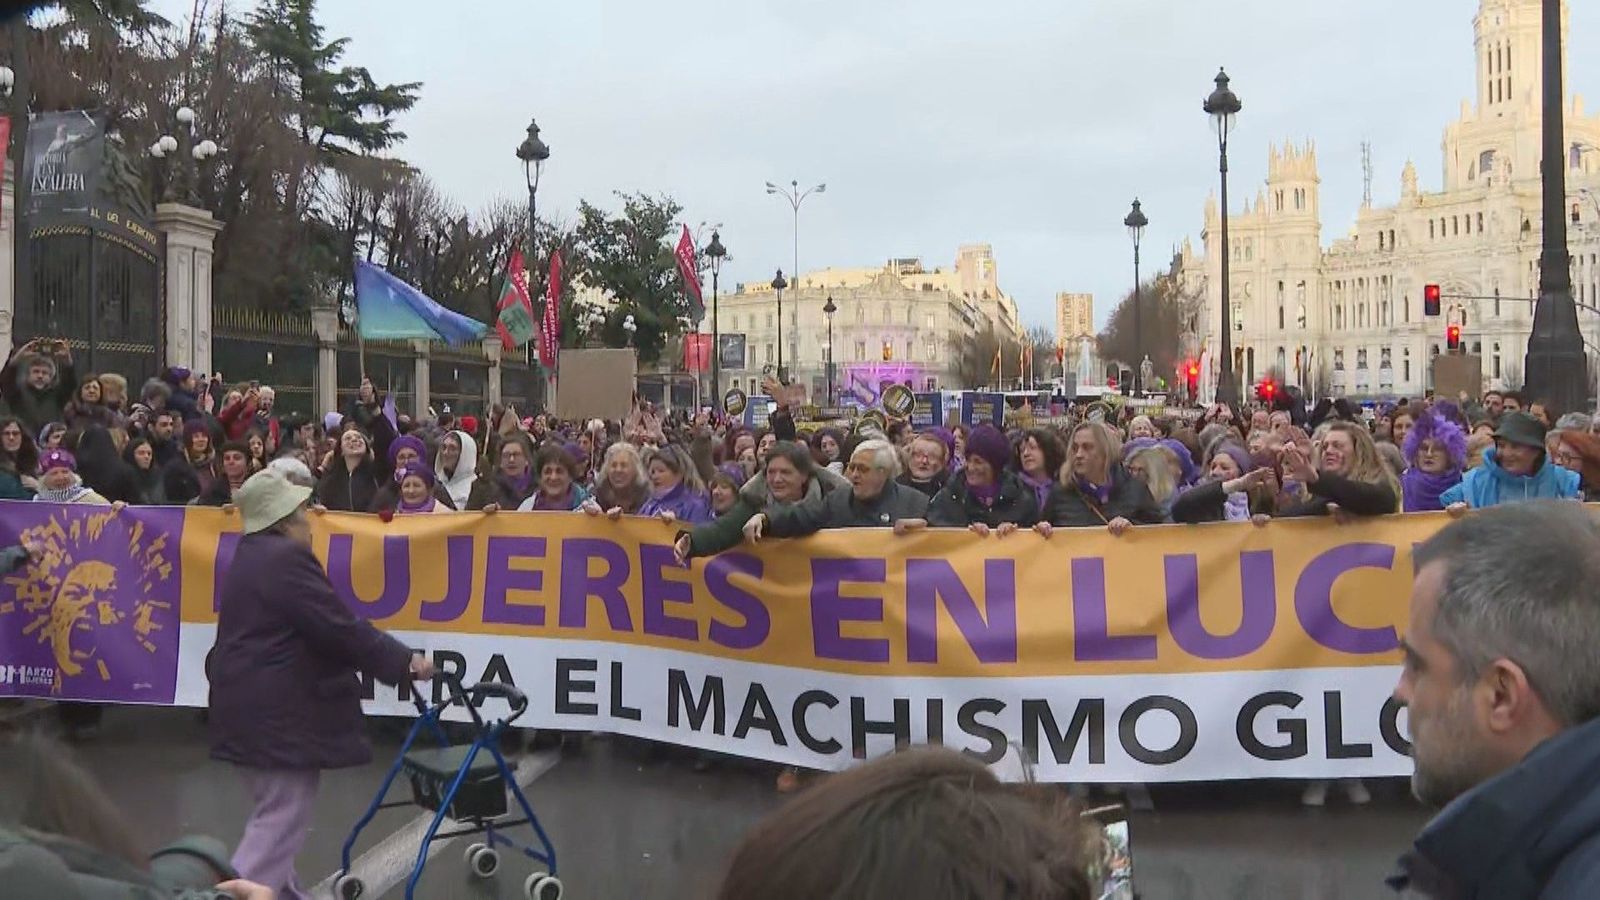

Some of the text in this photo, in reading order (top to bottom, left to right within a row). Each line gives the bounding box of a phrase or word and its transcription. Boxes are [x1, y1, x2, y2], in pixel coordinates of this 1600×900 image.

[213, 531, 1425, 664] UJERES EN LUC
[555, 657, 642, 721] EL
[667, 667, 1199, 766] MACHISMO
